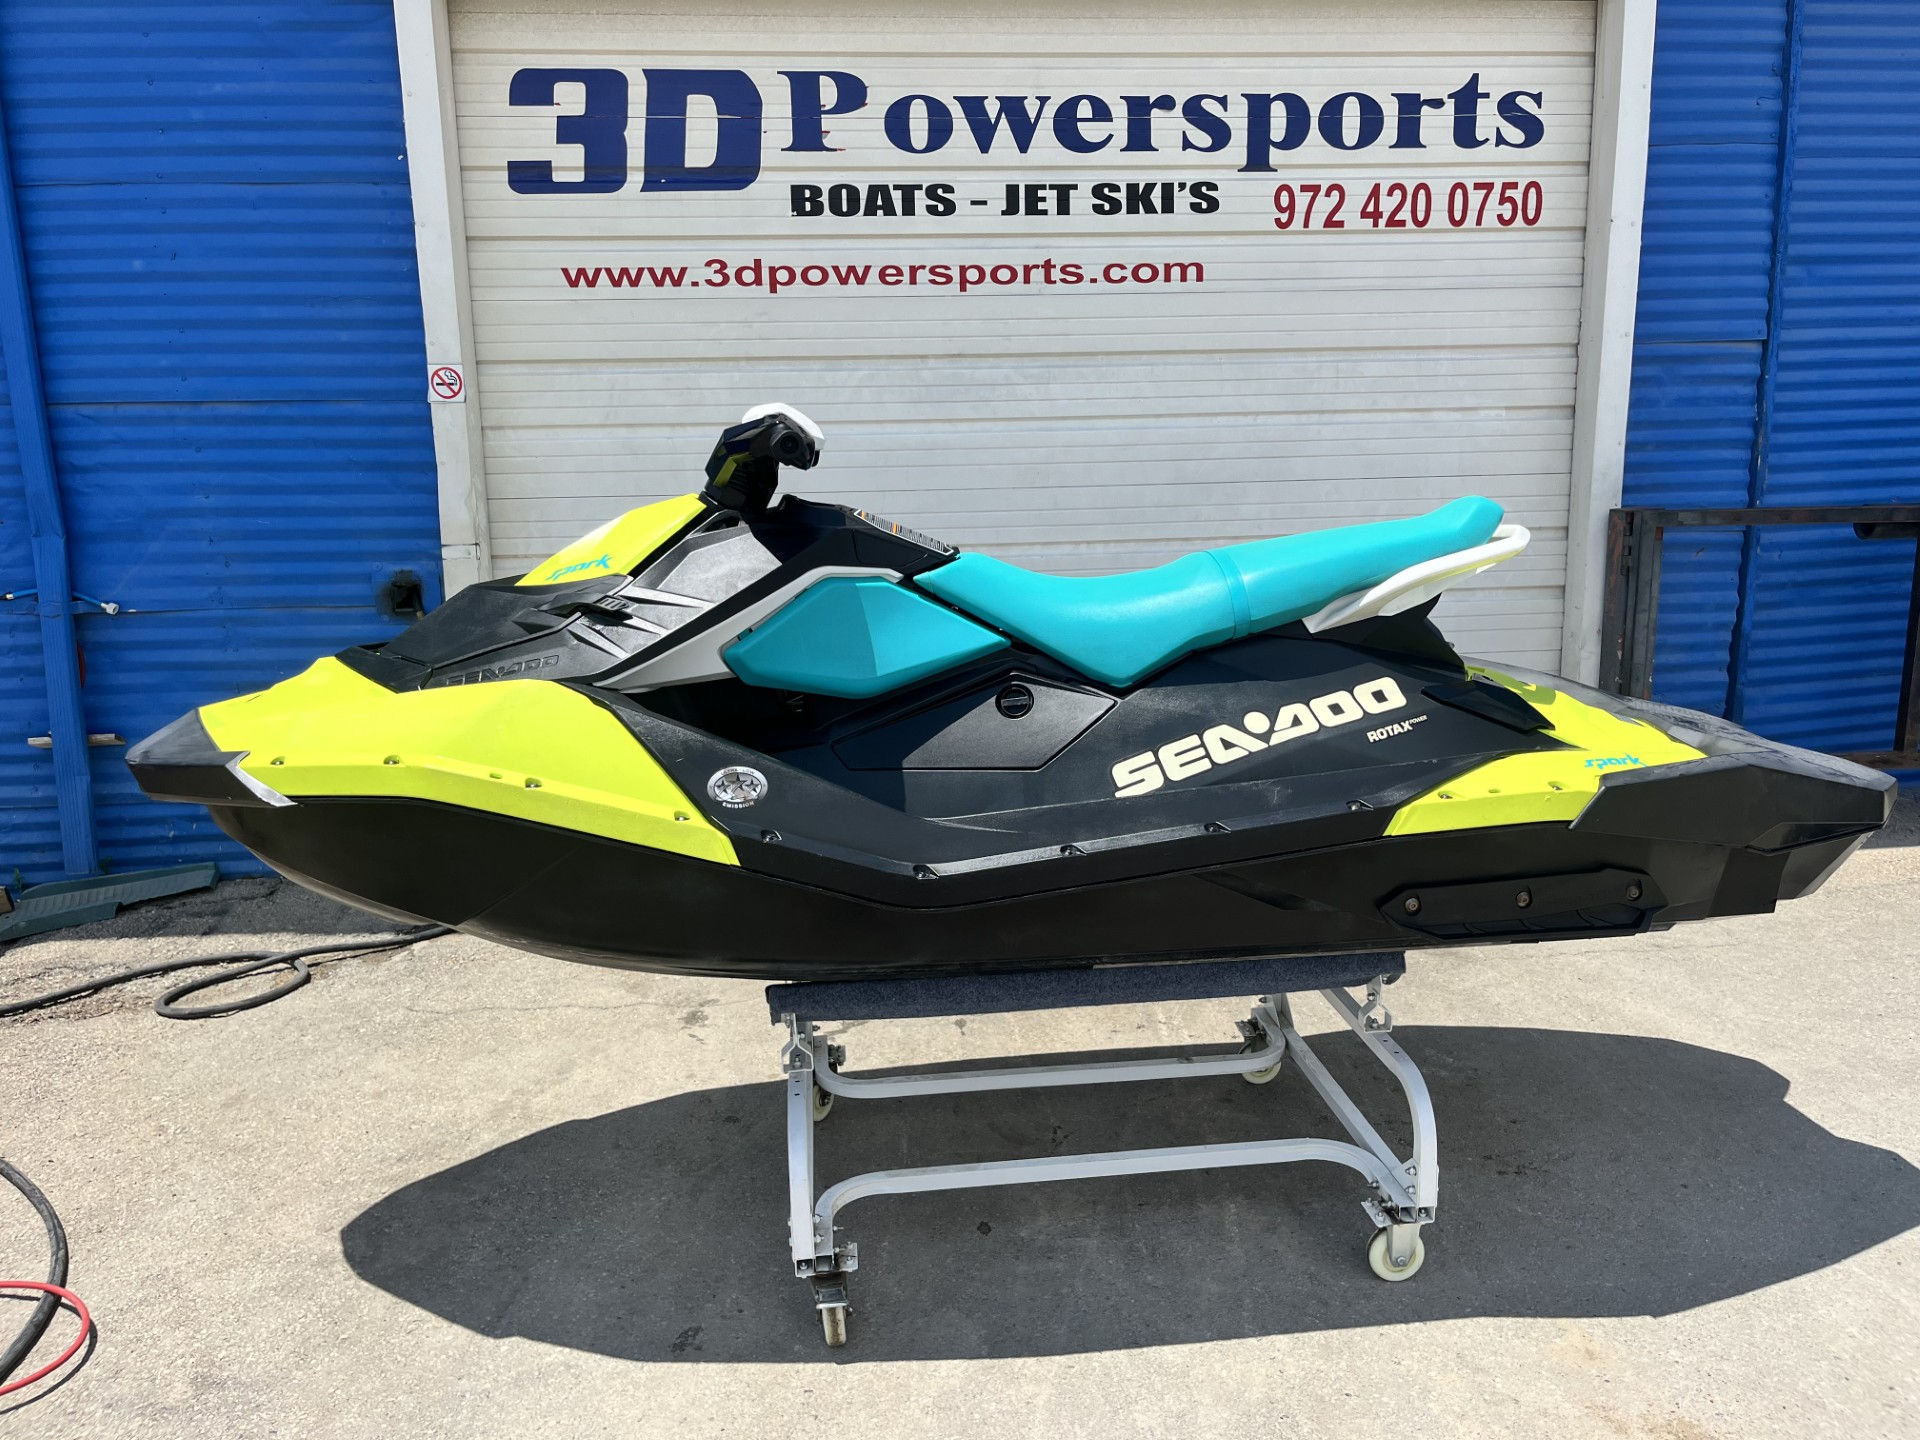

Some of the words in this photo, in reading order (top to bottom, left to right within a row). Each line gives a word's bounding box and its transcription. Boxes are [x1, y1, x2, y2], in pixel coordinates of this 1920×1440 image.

[507, 68, 763, 194] 3D
[777, 70, 1545, 172] Powersports
[791, 183, 956, 217] BOATS
[1000, 183, 1079, 216] JET
[1091, 181, 1220, 216] SKI'S
[1274, 183, 1346, 229] 972
[1360, 182, 1432, 228] 420
[1447, 180, 1543, 228] 0750
[561, 258, 1205, 293] www.3dpowersports.com
[545, 553, 612, 581] spark
[1366, 720, 1413, 743] ROTAX
[1584, 753, 1648, 769] spark
